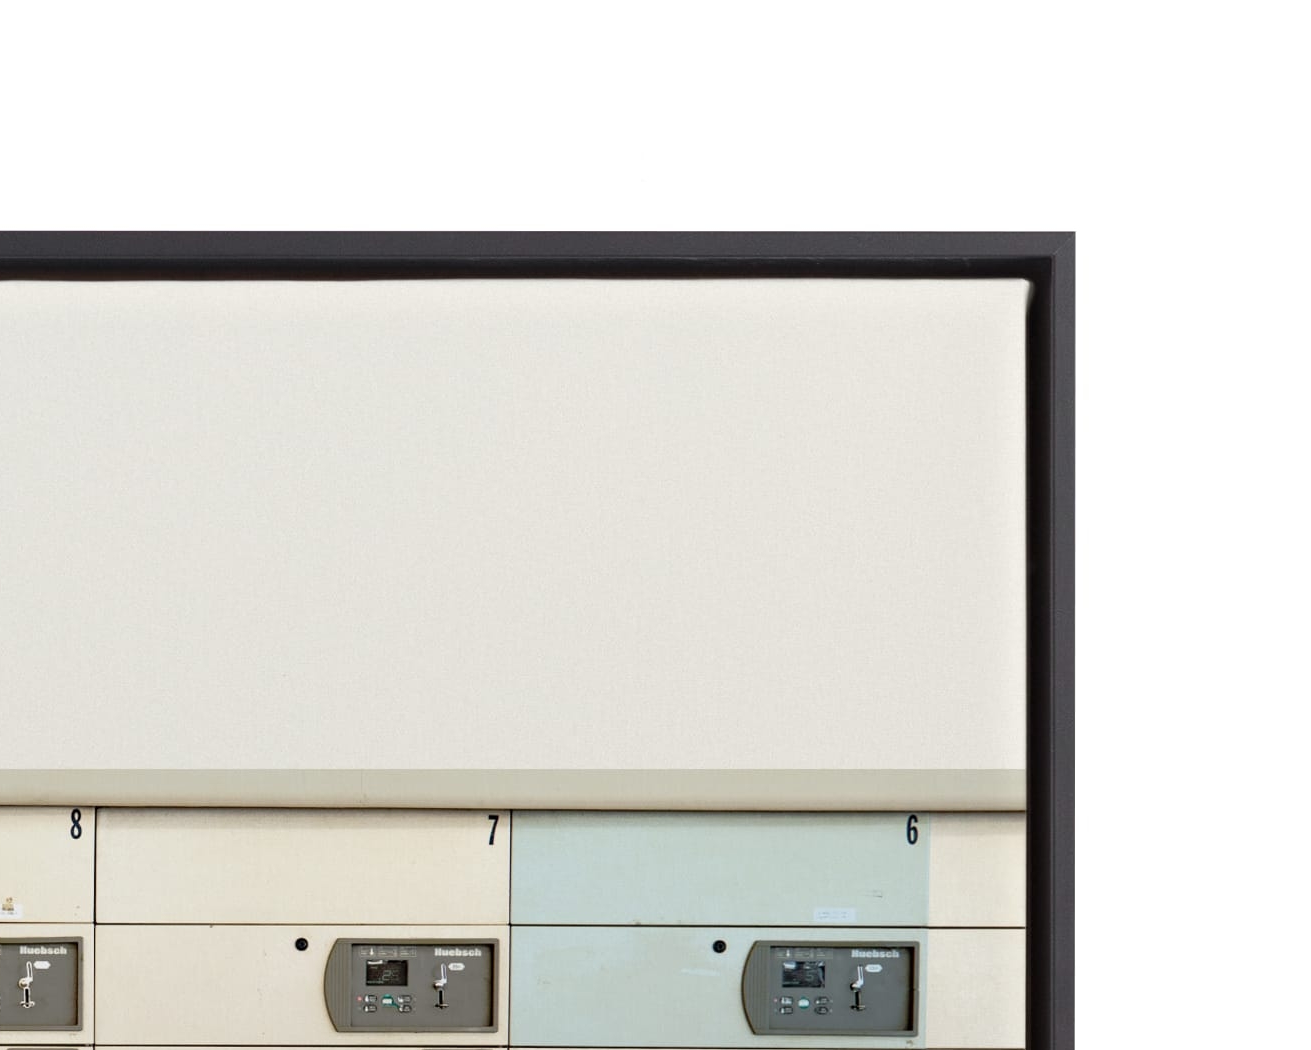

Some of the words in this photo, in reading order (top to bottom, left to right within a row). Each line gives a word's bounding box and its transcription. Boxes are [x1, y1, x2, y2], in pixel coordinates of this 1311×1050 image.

[70, 808, 83, 839] 8
[488, 814, 500, 845] 7
[906, 814, 919, 845] 6
[19, 946, 67, 955] Huebsch
[434, 948, 482, 957] Huebsch
[851, 949, 900, 958] Huebsch
